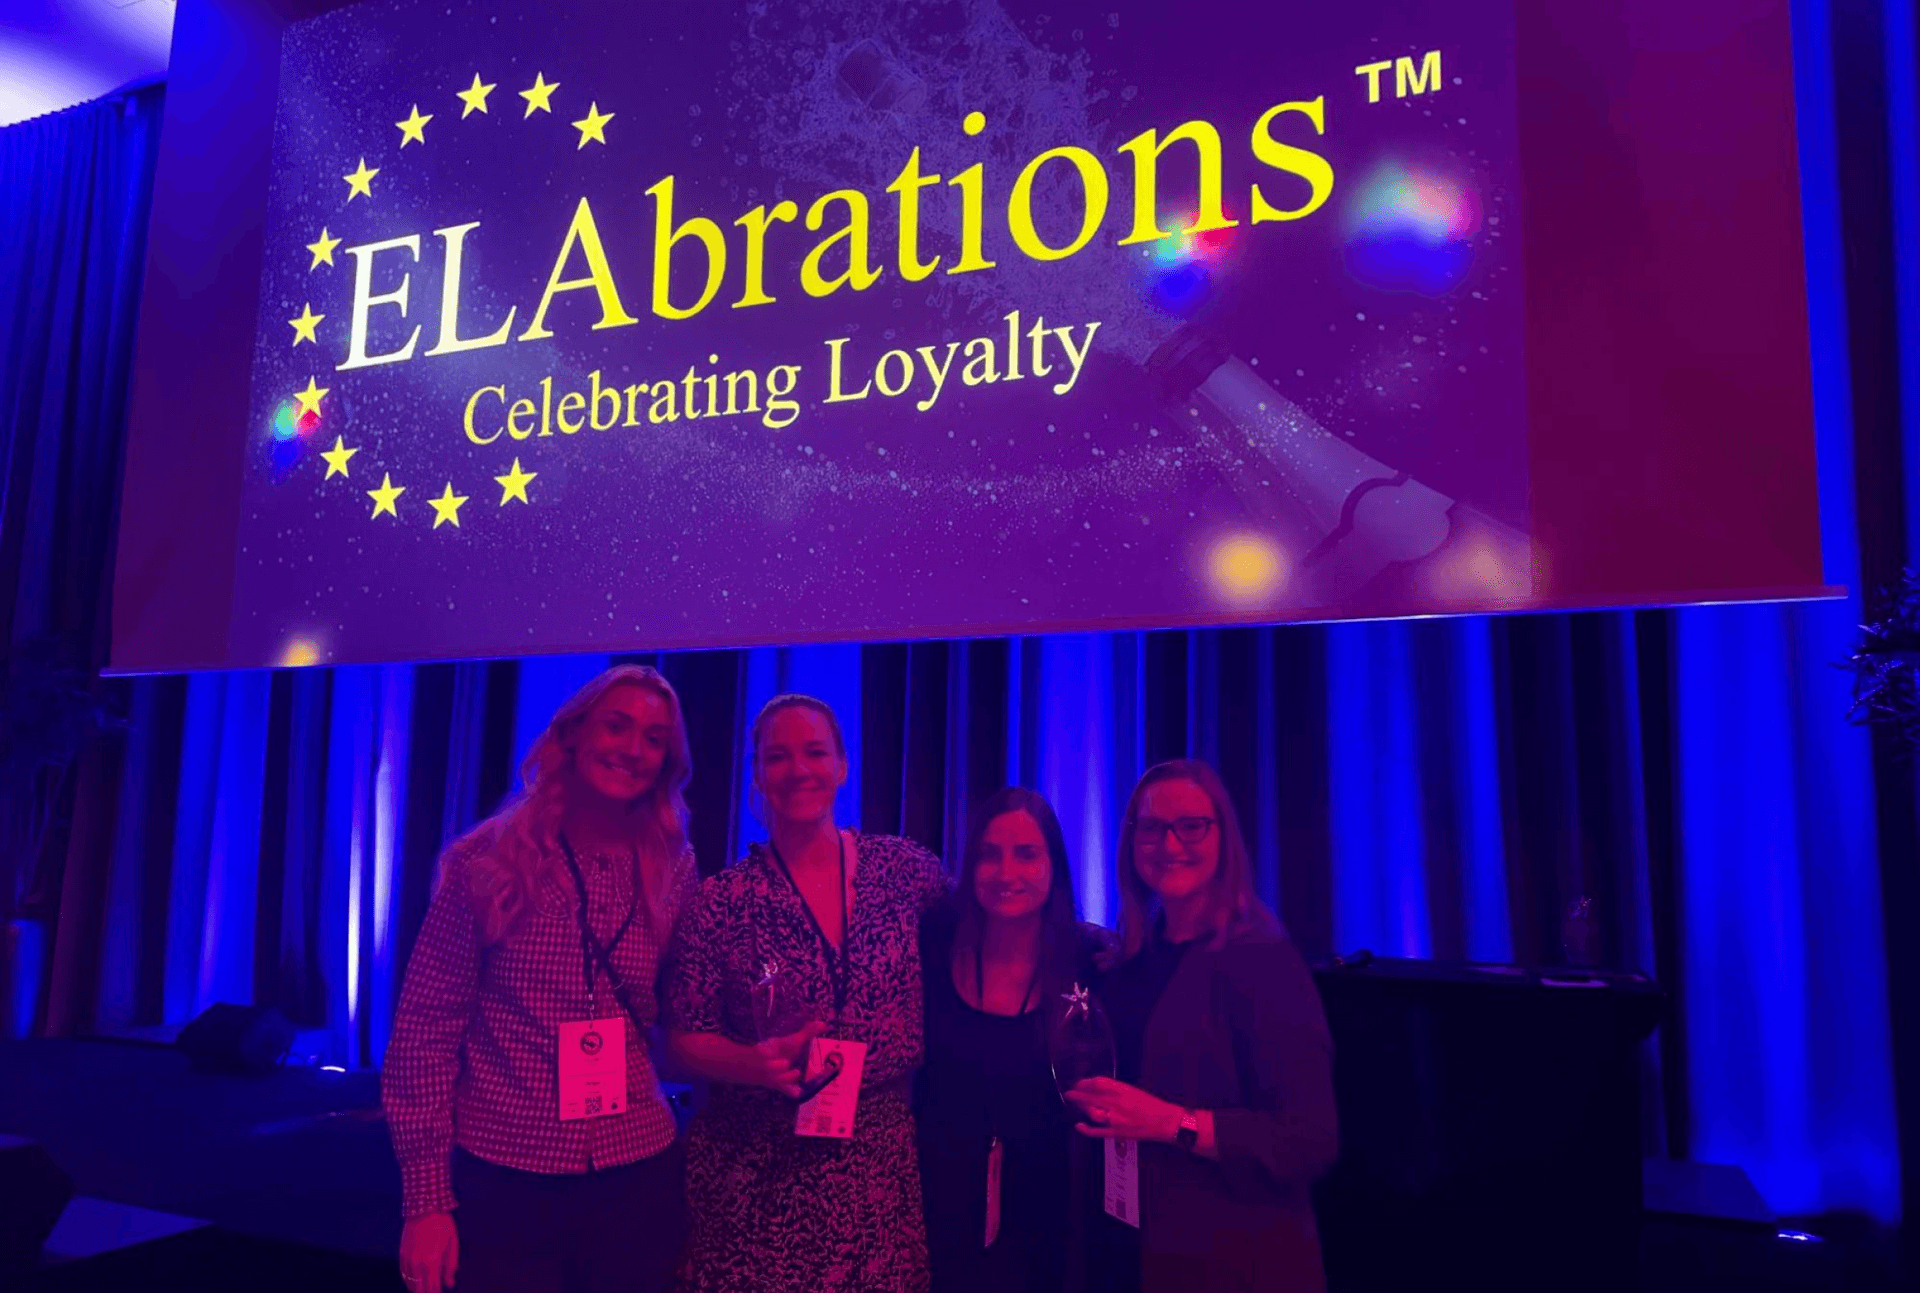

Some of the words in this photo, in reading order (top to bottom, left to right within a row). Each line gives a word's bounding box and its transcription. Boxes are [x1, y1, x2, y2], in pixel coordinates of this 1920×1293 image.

[335, 95, 1335, 371] ELAbrations
[1355, 50, 1442, 103] TM
[463, 353, 802, 445] Celebrating
[822, 309, 1102, 412] Loyalty
